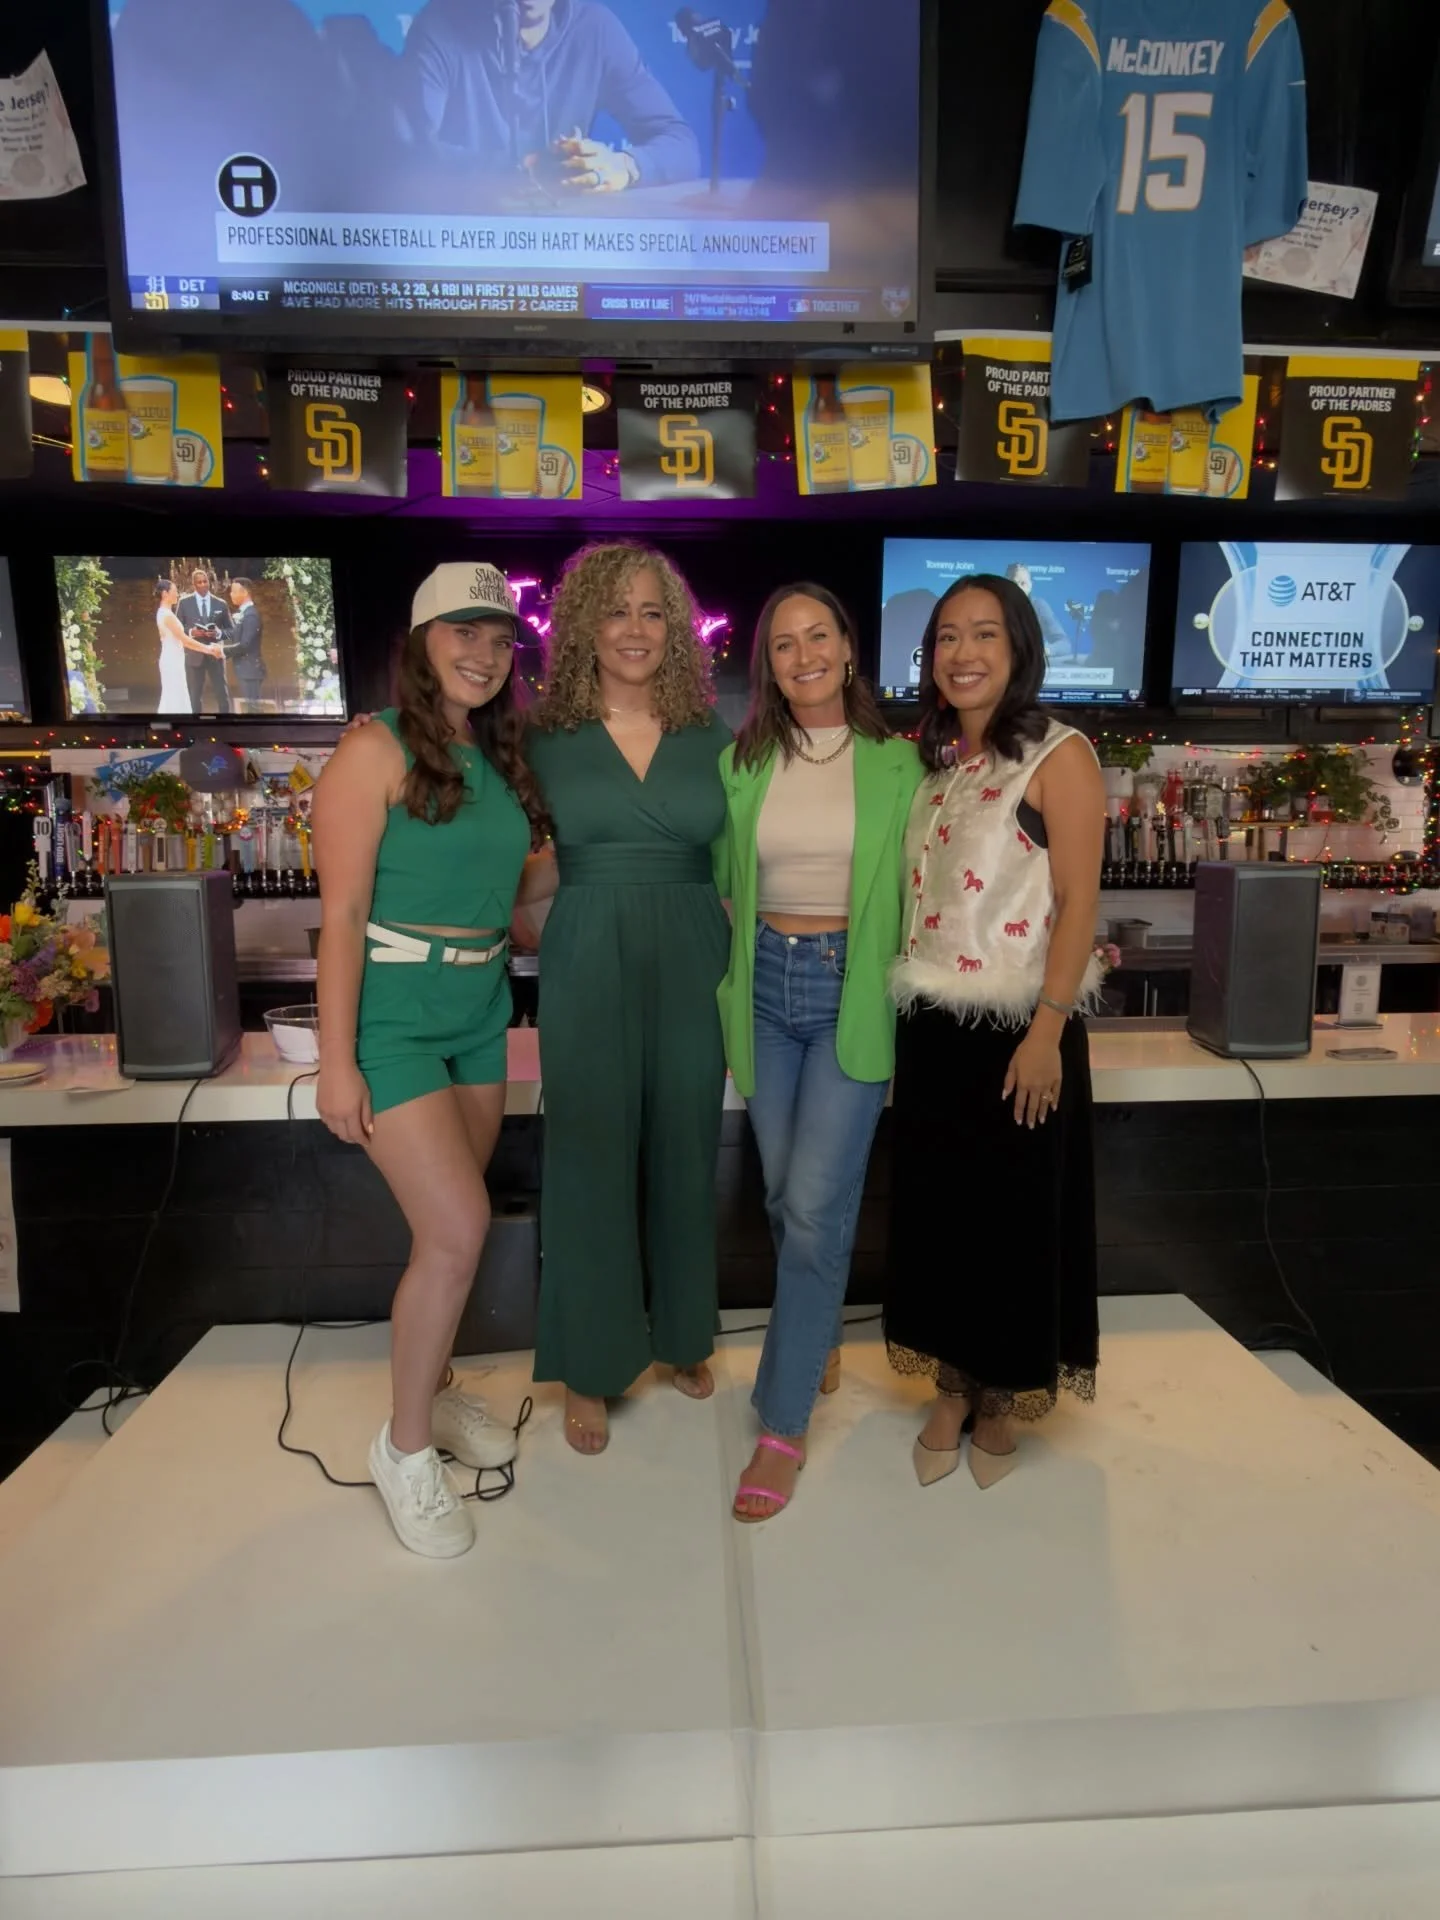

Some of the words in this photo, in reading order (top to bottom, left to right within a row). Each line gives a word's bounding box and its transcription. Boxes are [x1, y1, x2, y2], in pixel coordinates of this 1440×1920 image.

[1106, 37, 1225, 76] McCONKEY
[1116, 91, 1214, 215] 15
[228, 226, 337, 247] PROFESSIONAL
[343, 228, 435, 249] BASKETBALL
[441, 229, 495, 250] PLAYER
[500, 230, 536, 250] JOSH
[542, 231, 579, 251] HART
[584, 232, 633, 252] MAKES
[640, 233, 697, 253] SPECIAL
[702, 234, 817, 254] ANNOUNCEMENT
[180, 279, 206, 292] DET
[283, 281, 346, 294] MCGONIGLE
[349, 282, 378, 296] (DET):
[381, 282, 401, 296] 5-8,
[403, 283, 411, 295] 2
[413, 283, 430, 297] 2B,
[432, 283, 439, 295] 4
[441, 283, 460, 296] RBI
[462, 284, 473, 296] IN
[475, 284, 506, 297] FIRST
[507, 285, 515, 297] 2
[517, 285, 539, 297] MLB
[542, 285, 579, 298] GAMES
[180, 295, 200, 308] SD
[231, 290, 255, 301] 8:40
[257, 291, 270, 301] ET
[315, 297, 341, 309] HAD
[344, 297, 381, 309] MORE
[385, 298, 413, 309] HITS
[417, 299, 477, 310] THROUGH
[480, 300, 515, 311] FIRST
[518, 300, 527, 311] 2
[530, 300, 578, 311] CAREER
[629, 298, 650, 309] TEXT
[812, 300, 860, 313] TOGETHER
[288, 369, 326, 382] PROUD
[328, 372, 381, 388] PARTNER
[987, 366, 1020, 381] PROUD
[1022, 370, 1051, 383] PART
[291, 384, 307, 396] OF
[308, 385, 330, 397] THE
[333, 386, 378, 401] PADRES
[640, 383, 679, 395] PROUD
[681, 382, 732, 395] PARTNER
[988, 380, 1002, 392] OF
[1003, 382, 1022, 396] THE
[1024, 385, 1051, 397] PAD
[1309, 385, 1347, 397] PROUD
[1348, 386, 1396, 399] PARTNER
[644, 398, 660, 408] OF
[661, 397, 683, 408] THE
[685, 395, 729, 409] PADRES
[1311, 399, 1328, 410] OF
[1328, 400, 1349, 411] THE
[1351, 400, 1392, 412] PADRES
[306, 403, 361, 481] SD
[998, 400, 1048, 475] SD
[660, 414, 714, 488] SD
[1321, 416, 1373, 489] SD
[926, 560, 954, 571] Tommy
[955, 560, 975, 570] John
[1027, 565, 1047, 574] mmy
[1048, 564, 1065, 574] John
[1106, 567, 1128, 577] Tommy
[1129, 568, 1140, 576] Jo
[1301, 582, 1356, 602] AT&T
[1251, 631, 1364, 648] CONNECTION
[1240, 651, 1288, 668] THAT
[1290, 652, 1373, 669] MATTERS
[36, 821, 49, 835] 10
[57, 823, 65, 845] LIGHT
[56, 846, 64, 863] BUD
